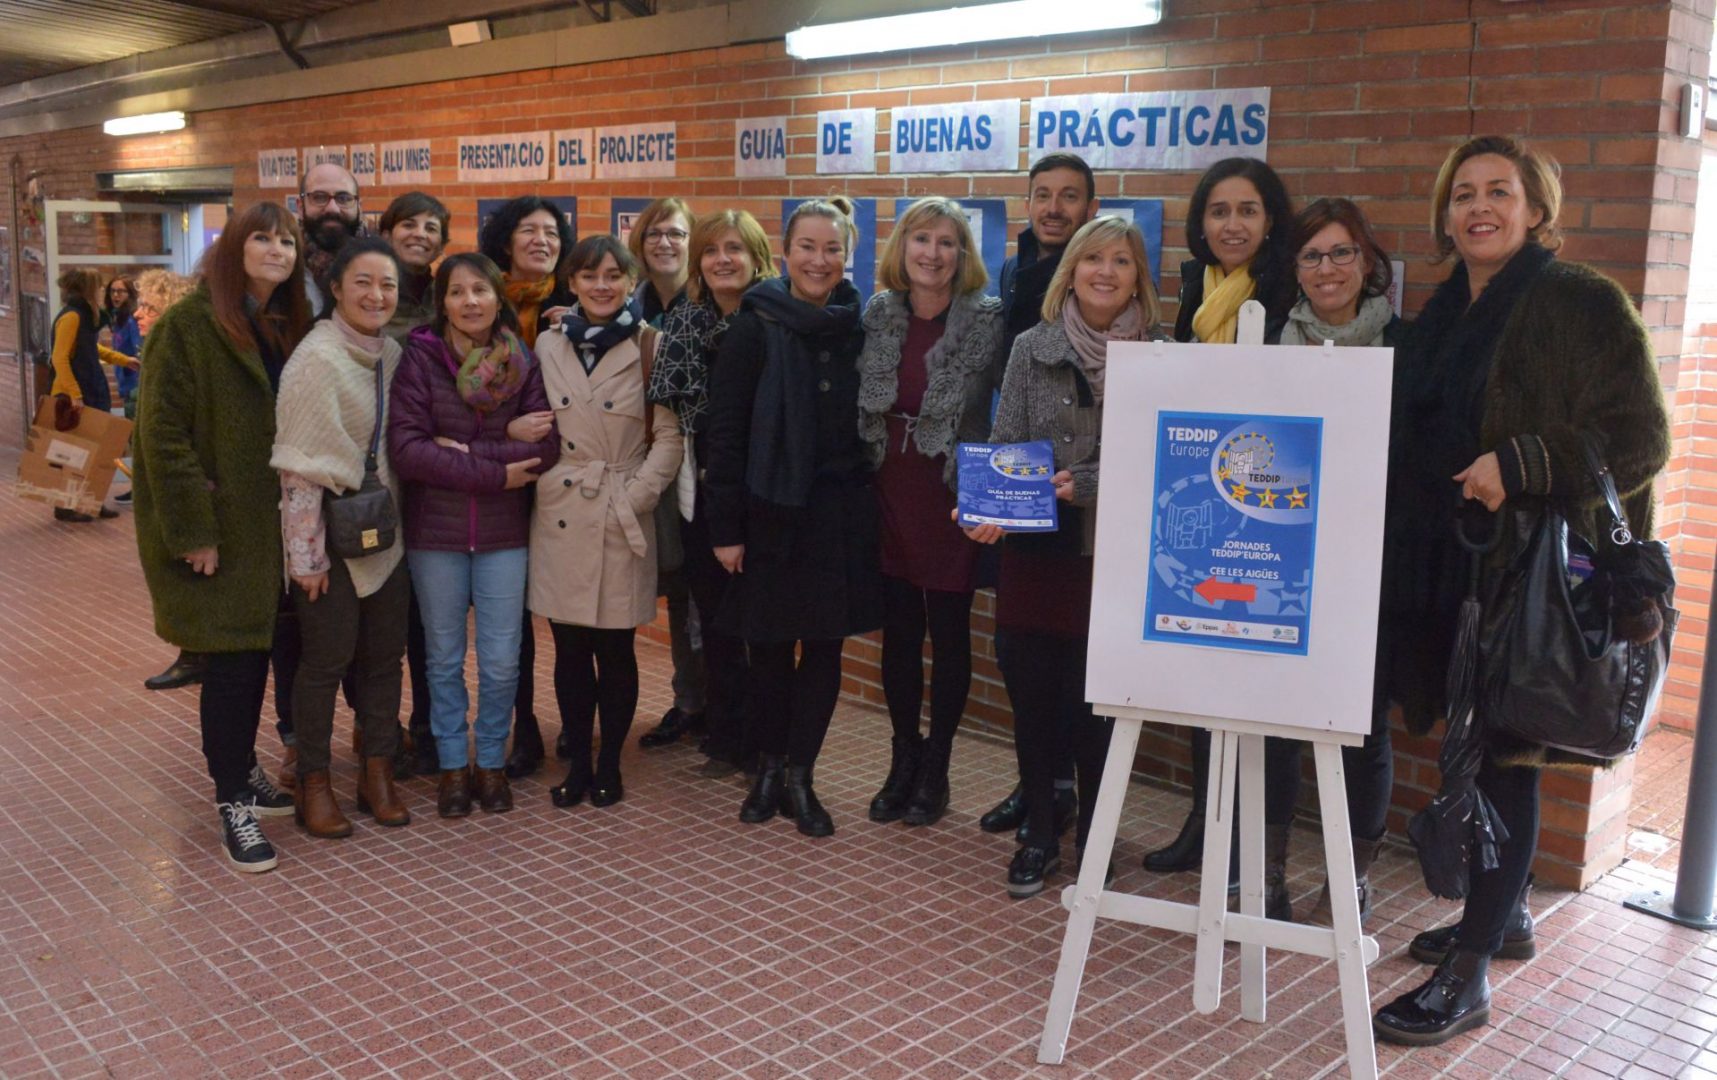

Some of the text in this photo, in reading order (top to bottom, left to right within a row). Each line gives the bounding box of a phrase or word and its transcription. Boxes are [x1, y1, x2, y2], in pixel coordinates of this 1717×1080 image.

[822, 121, 853, 155] DE
[897, 114, 993, 154] BUENAS
[1036, 103, 1268, 148] PRÁCTICAS
[460, 132, 675, 169] PRESENTACIÓ DEL PROJECTE
[260, 156, 297, 177] VIATGE
[352, 151, 375, 173] DELS
[382, 147, 430, 173] ALUMNES
[1167, 427, 1218, 442] TEDDIP
[1170, 443, 1210, 458] Europe
[1248, 473, 1281, 484] TEDDIP
[1223, 540, 1271, 552] JORNADES
[1209, 566, 1279, 580] CEE LES AIGÜES
